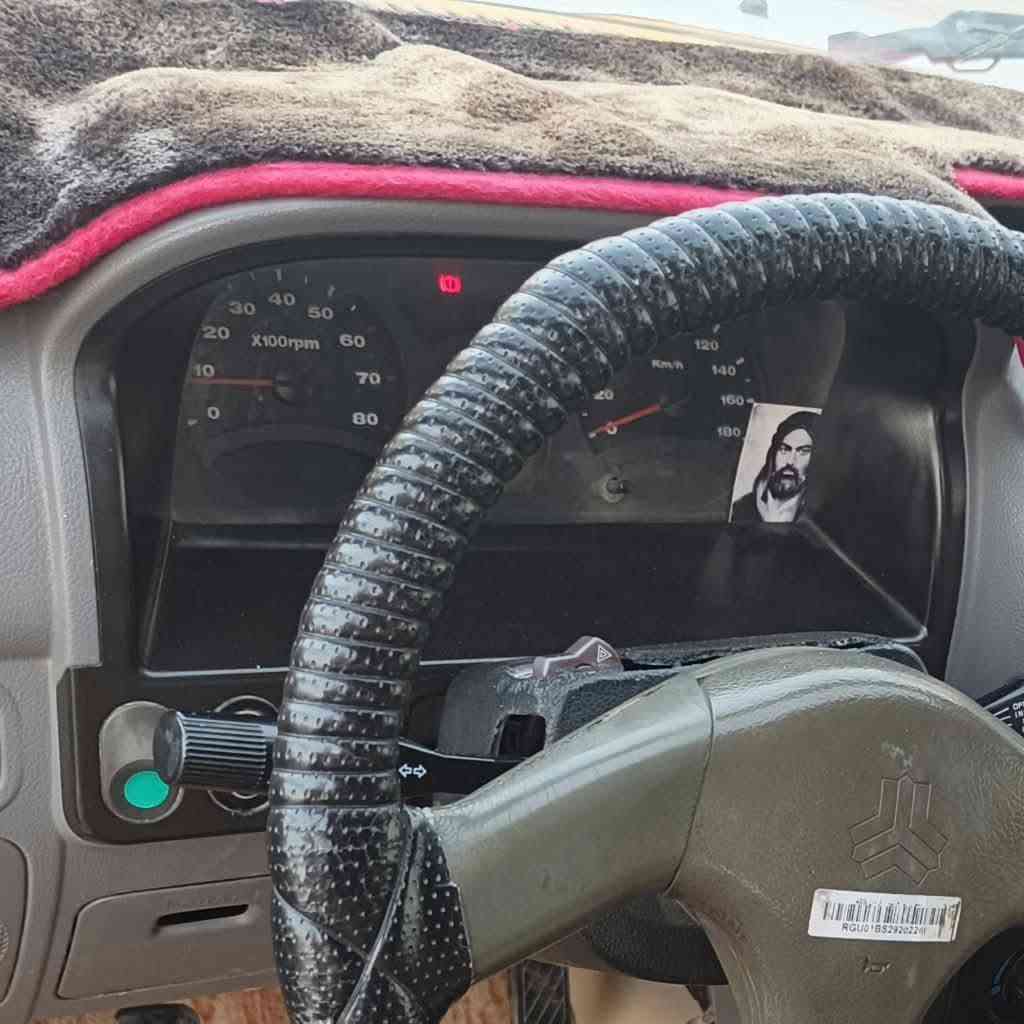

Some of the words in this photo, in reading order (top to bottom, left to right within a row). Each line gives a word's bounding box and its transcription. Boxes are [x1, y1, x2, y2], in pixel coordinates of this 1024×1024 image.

[268, 292, 296, 306] 40
[228, 301, 256, 316] 30
[307, 306, 334, 320] 50
[201, 325, 230, 340] 20
[251, 333, 320, 351] X100rpm
[339, 334, 366, 348] 60
[694, 339, 719, 351] 120
[194, 363, 216, 377] 10
[711, 364, 737, 376] 140
[354, 371, 381, 385] 70
[720, 394, 745, 407] 160
[207, 406, 221, 420] 0
[352, 412, 379, 426] 80
[717, 427, 741, 438] 180
